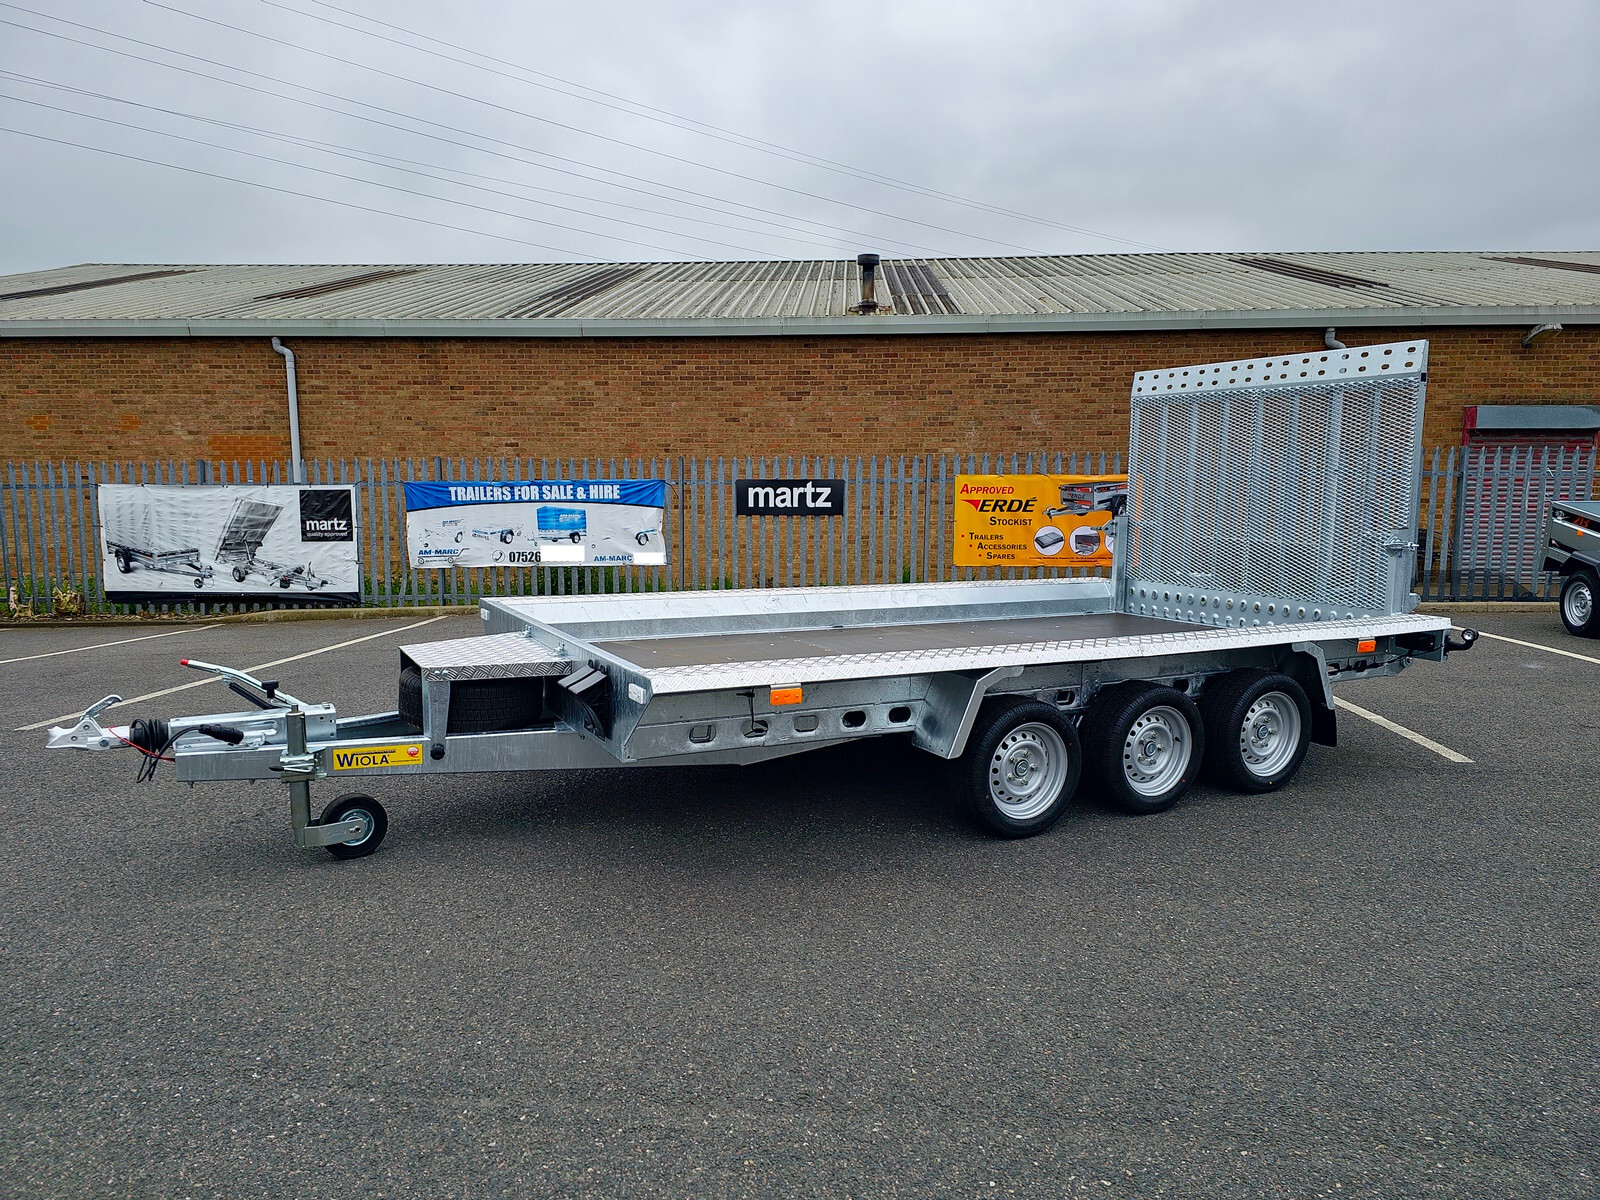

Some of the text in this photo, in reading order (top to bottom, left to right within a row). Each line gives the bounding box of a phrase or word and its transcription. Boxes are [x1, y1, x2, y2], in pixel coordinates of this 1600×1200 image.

[449, 484, 621, 501] TRAILERS FOR SALE & HIRE
[748, 480, 832, 508] martz
[960, 483, 1015, 495] APPROVED
[978, 496, 1038, 513] ERDÉ
[305, 517, 347, 531] martz
[989, 516, 1033, 526] STOCKIST
[969, 532, 1004, 540] TRAILERS
[418, 548, 459, 556] AM-MARC
[977, 542, 1028, 550] ACCESSORIES
[509, 551, 541, 563] 07526
[593, 554, 633, 562] AM-MARC
[986, 552, 1016, 560] SPARES
[336, 753, 389, 767] WIOLA
